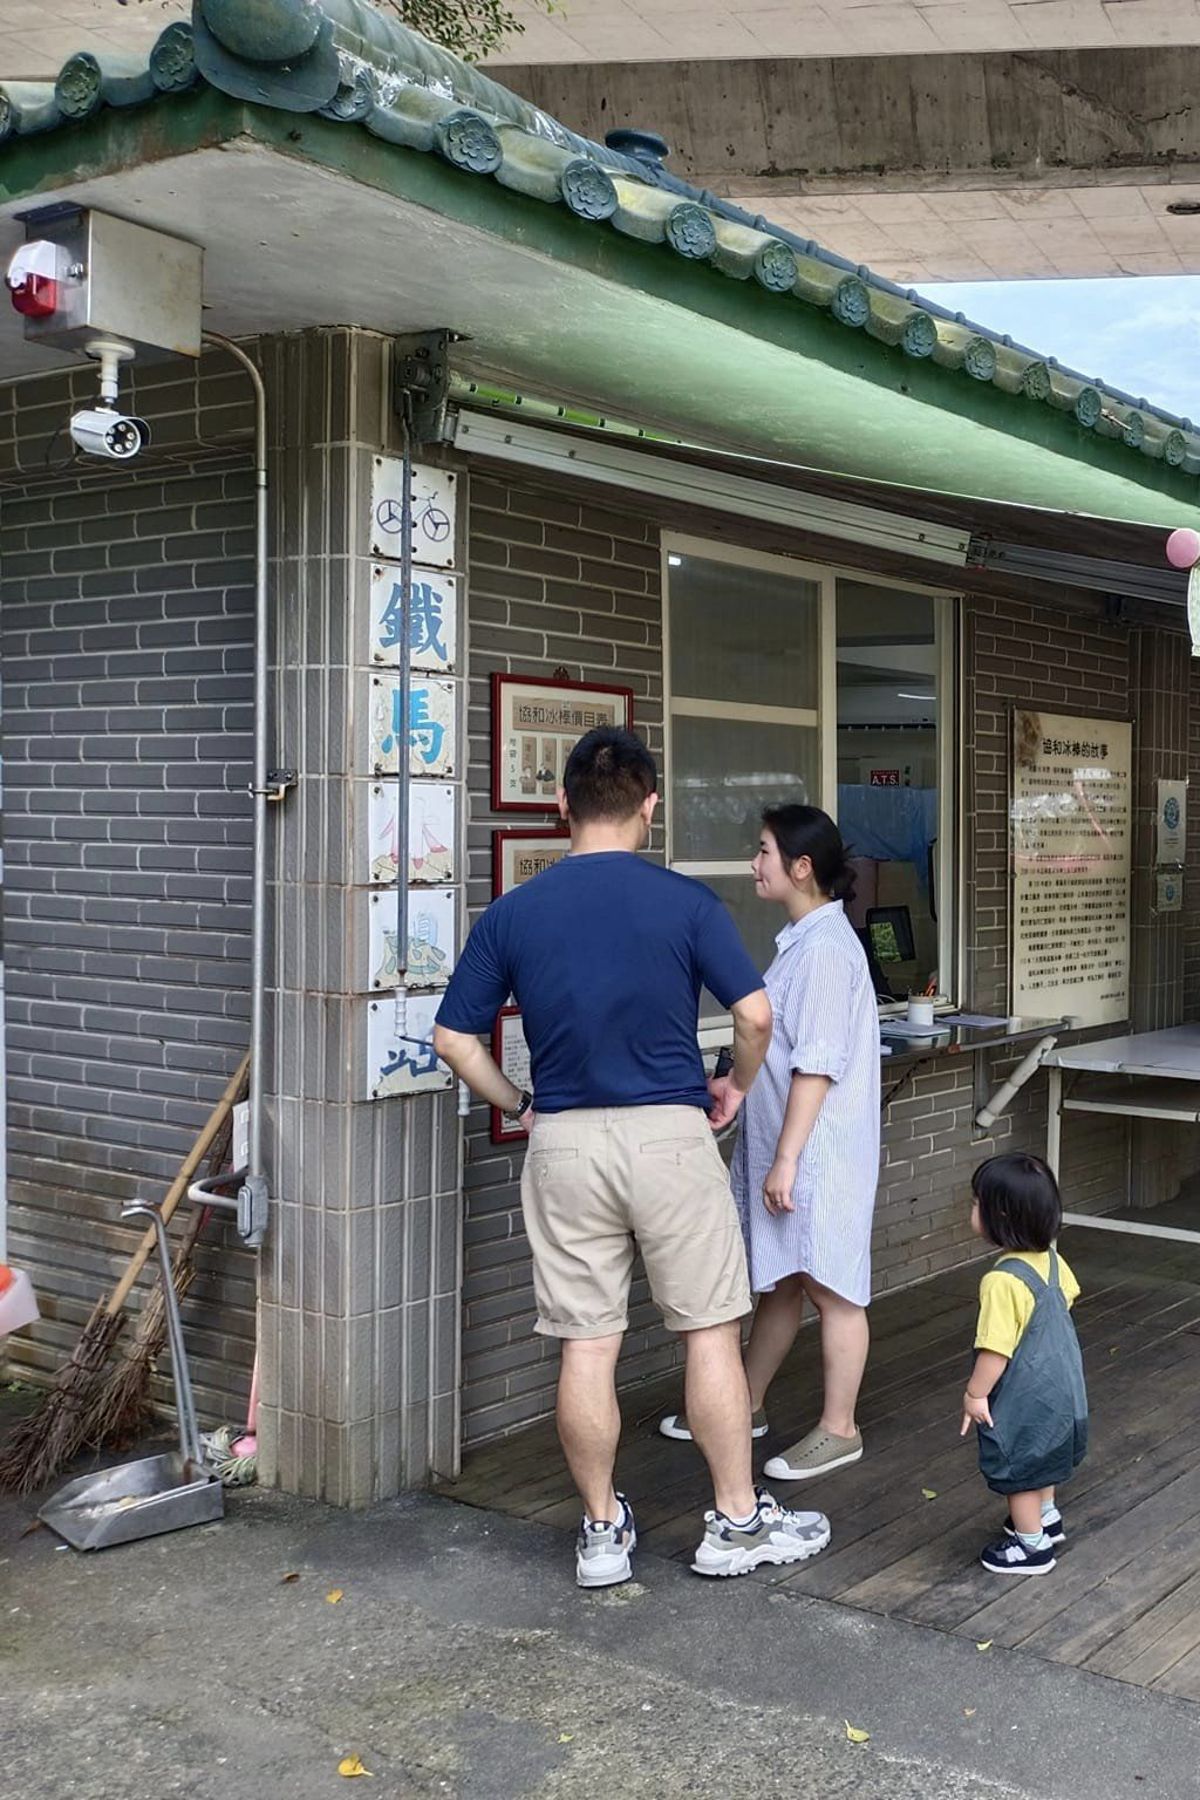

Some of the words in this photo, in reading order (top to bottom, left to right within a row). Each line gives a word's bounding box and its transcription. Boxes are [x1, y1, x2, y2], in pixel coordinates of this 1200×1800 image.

[1042, 738, 1109, 760] 協和冰棒的故事
